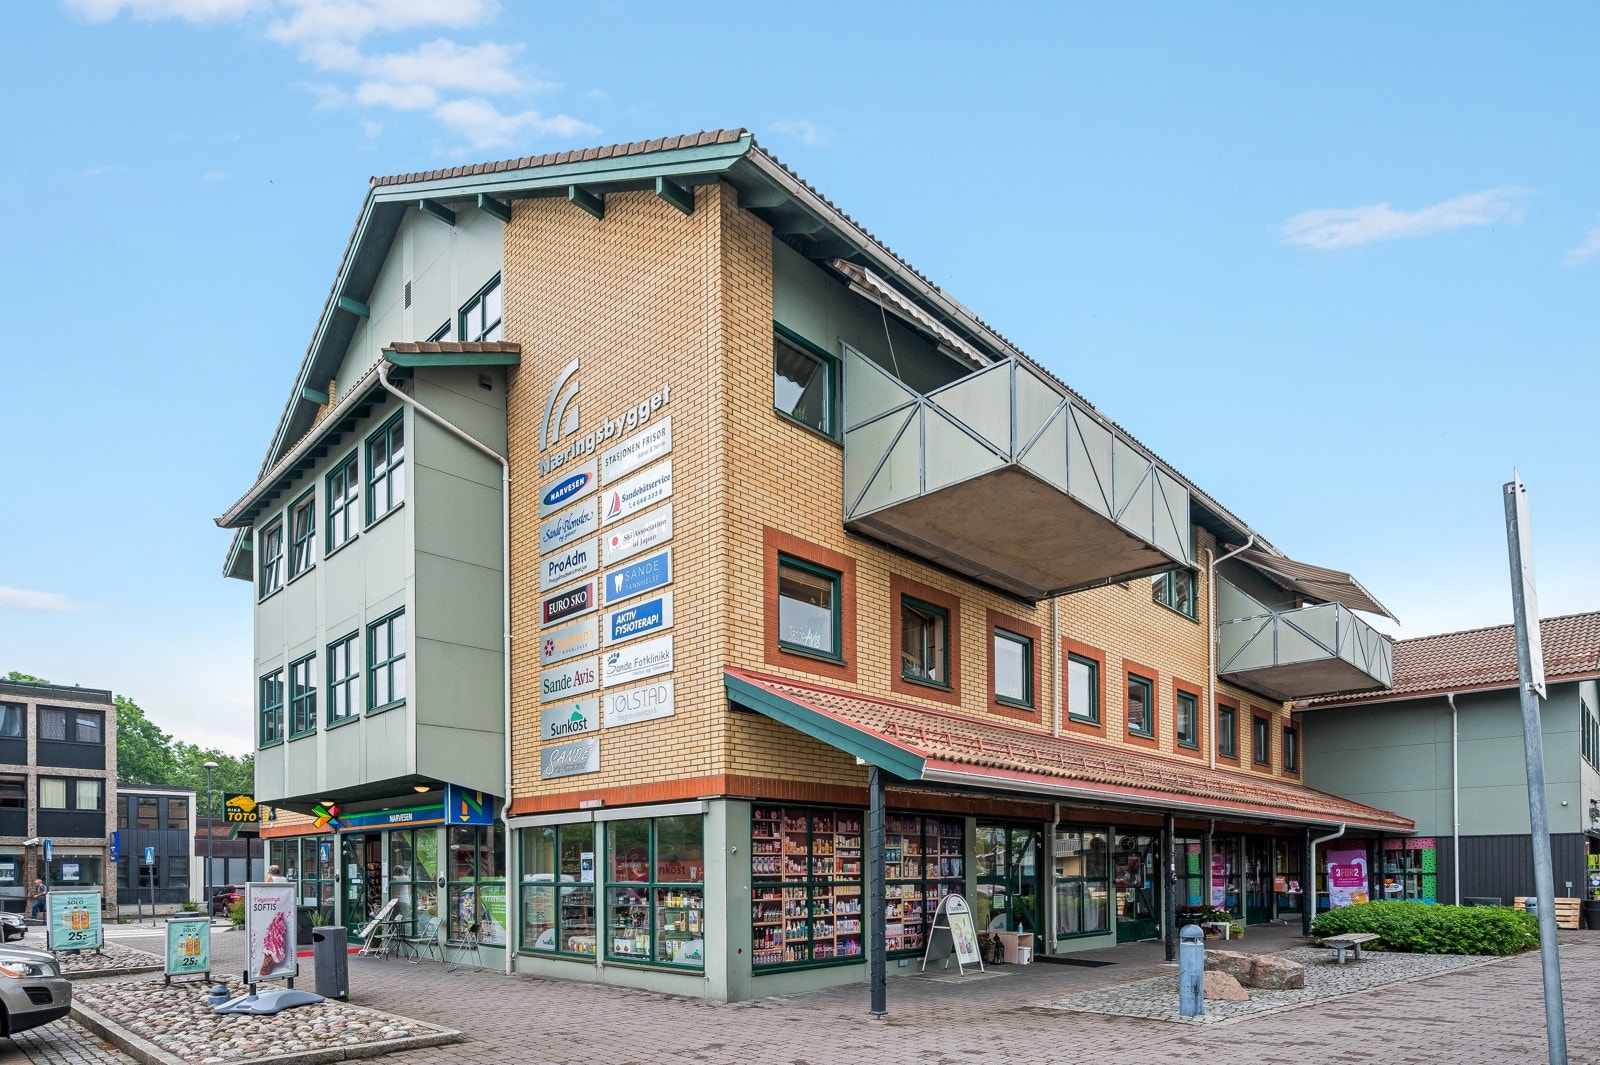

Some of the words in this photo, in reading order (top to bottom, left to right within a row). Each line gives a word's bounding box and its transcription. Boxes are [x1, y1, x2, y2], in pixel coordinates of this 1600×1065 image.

[538, 383, 671, 478] Næringsbygget
[605, 441, 641, 467] STASJONEN
[642, 427, 666, 448] FRISØR
[550, 476, 585, 502] NARVESEN
[621, 474, 671, 503] Sandebåtservice
[634, 519, 667, 537] Association
[549, 549, 587, 577] ProAdm
[625, 559, 659, 582] SANDE
[626, 573, 660, 591] TANNHELSE
[548, 597, 570, 615] EURO
[570, 590, 588, 607] SKO
[615, 613, 660, 636] FYSIOTERAPI
[616, 609, 637, 625] AKTIV
[606, 660, 633, 675] Sande
[634, 650, 670, 668] Fotklinikk
[543, 674, 572, 695] Sande
[573, 668, 595, 688] Avis
[609, 685, 668, 715] JØLSTAD
[550, 717, 588, 737] Sunkost
[228, 812, 257, 822] TOTO
[389, 812, 413, 823] NARVESEN
[659, 863, 686, 875] nkost
[253, 903, 277, 912] SOFTIS
